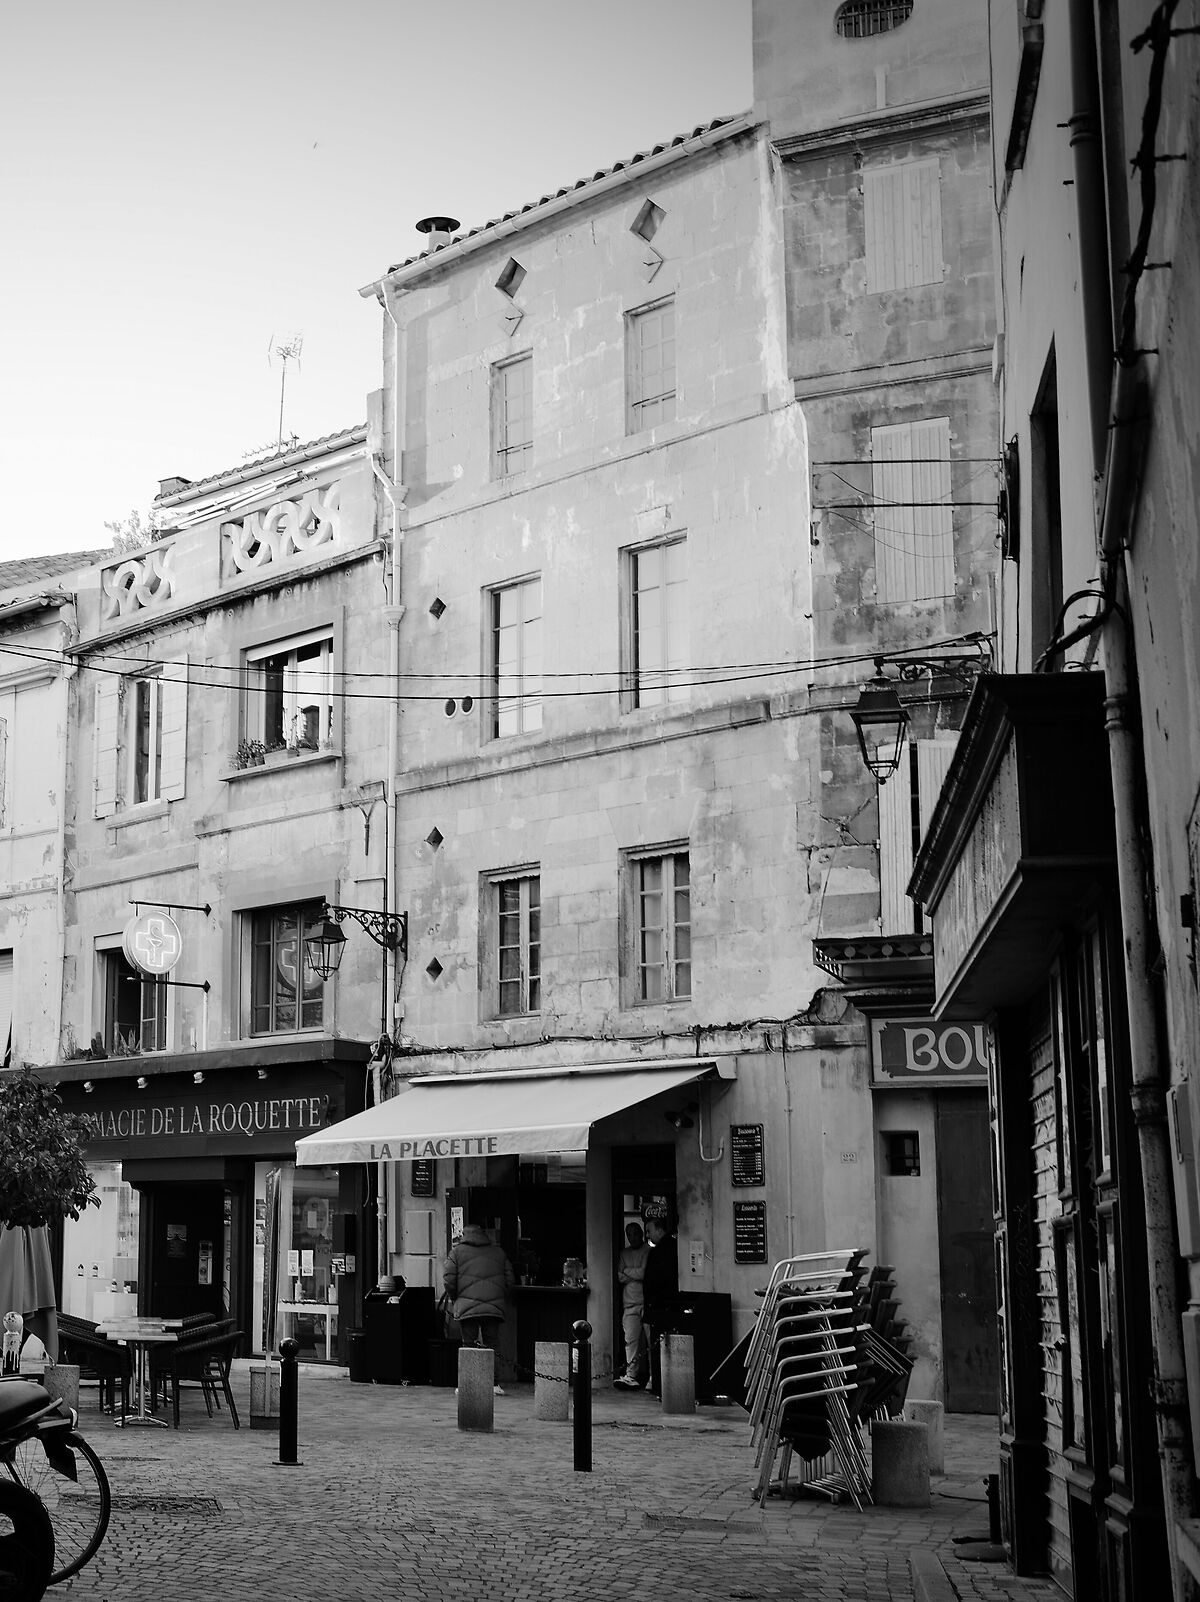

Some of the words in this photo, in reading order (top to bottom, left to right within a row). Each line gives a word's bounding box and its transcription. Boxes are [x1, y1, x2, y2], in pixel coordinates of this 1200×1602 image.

[93, 1108, 146, 1137] MACIE
[151, 1107, 175, 1135] DE
[180, 1105, 204, 1134] LA
[209, 1097, 321, 1137] ROQUETTE
[370, 1143, 392, 1160] LA
[400, 1136, 498, 1158] PLACETTE
